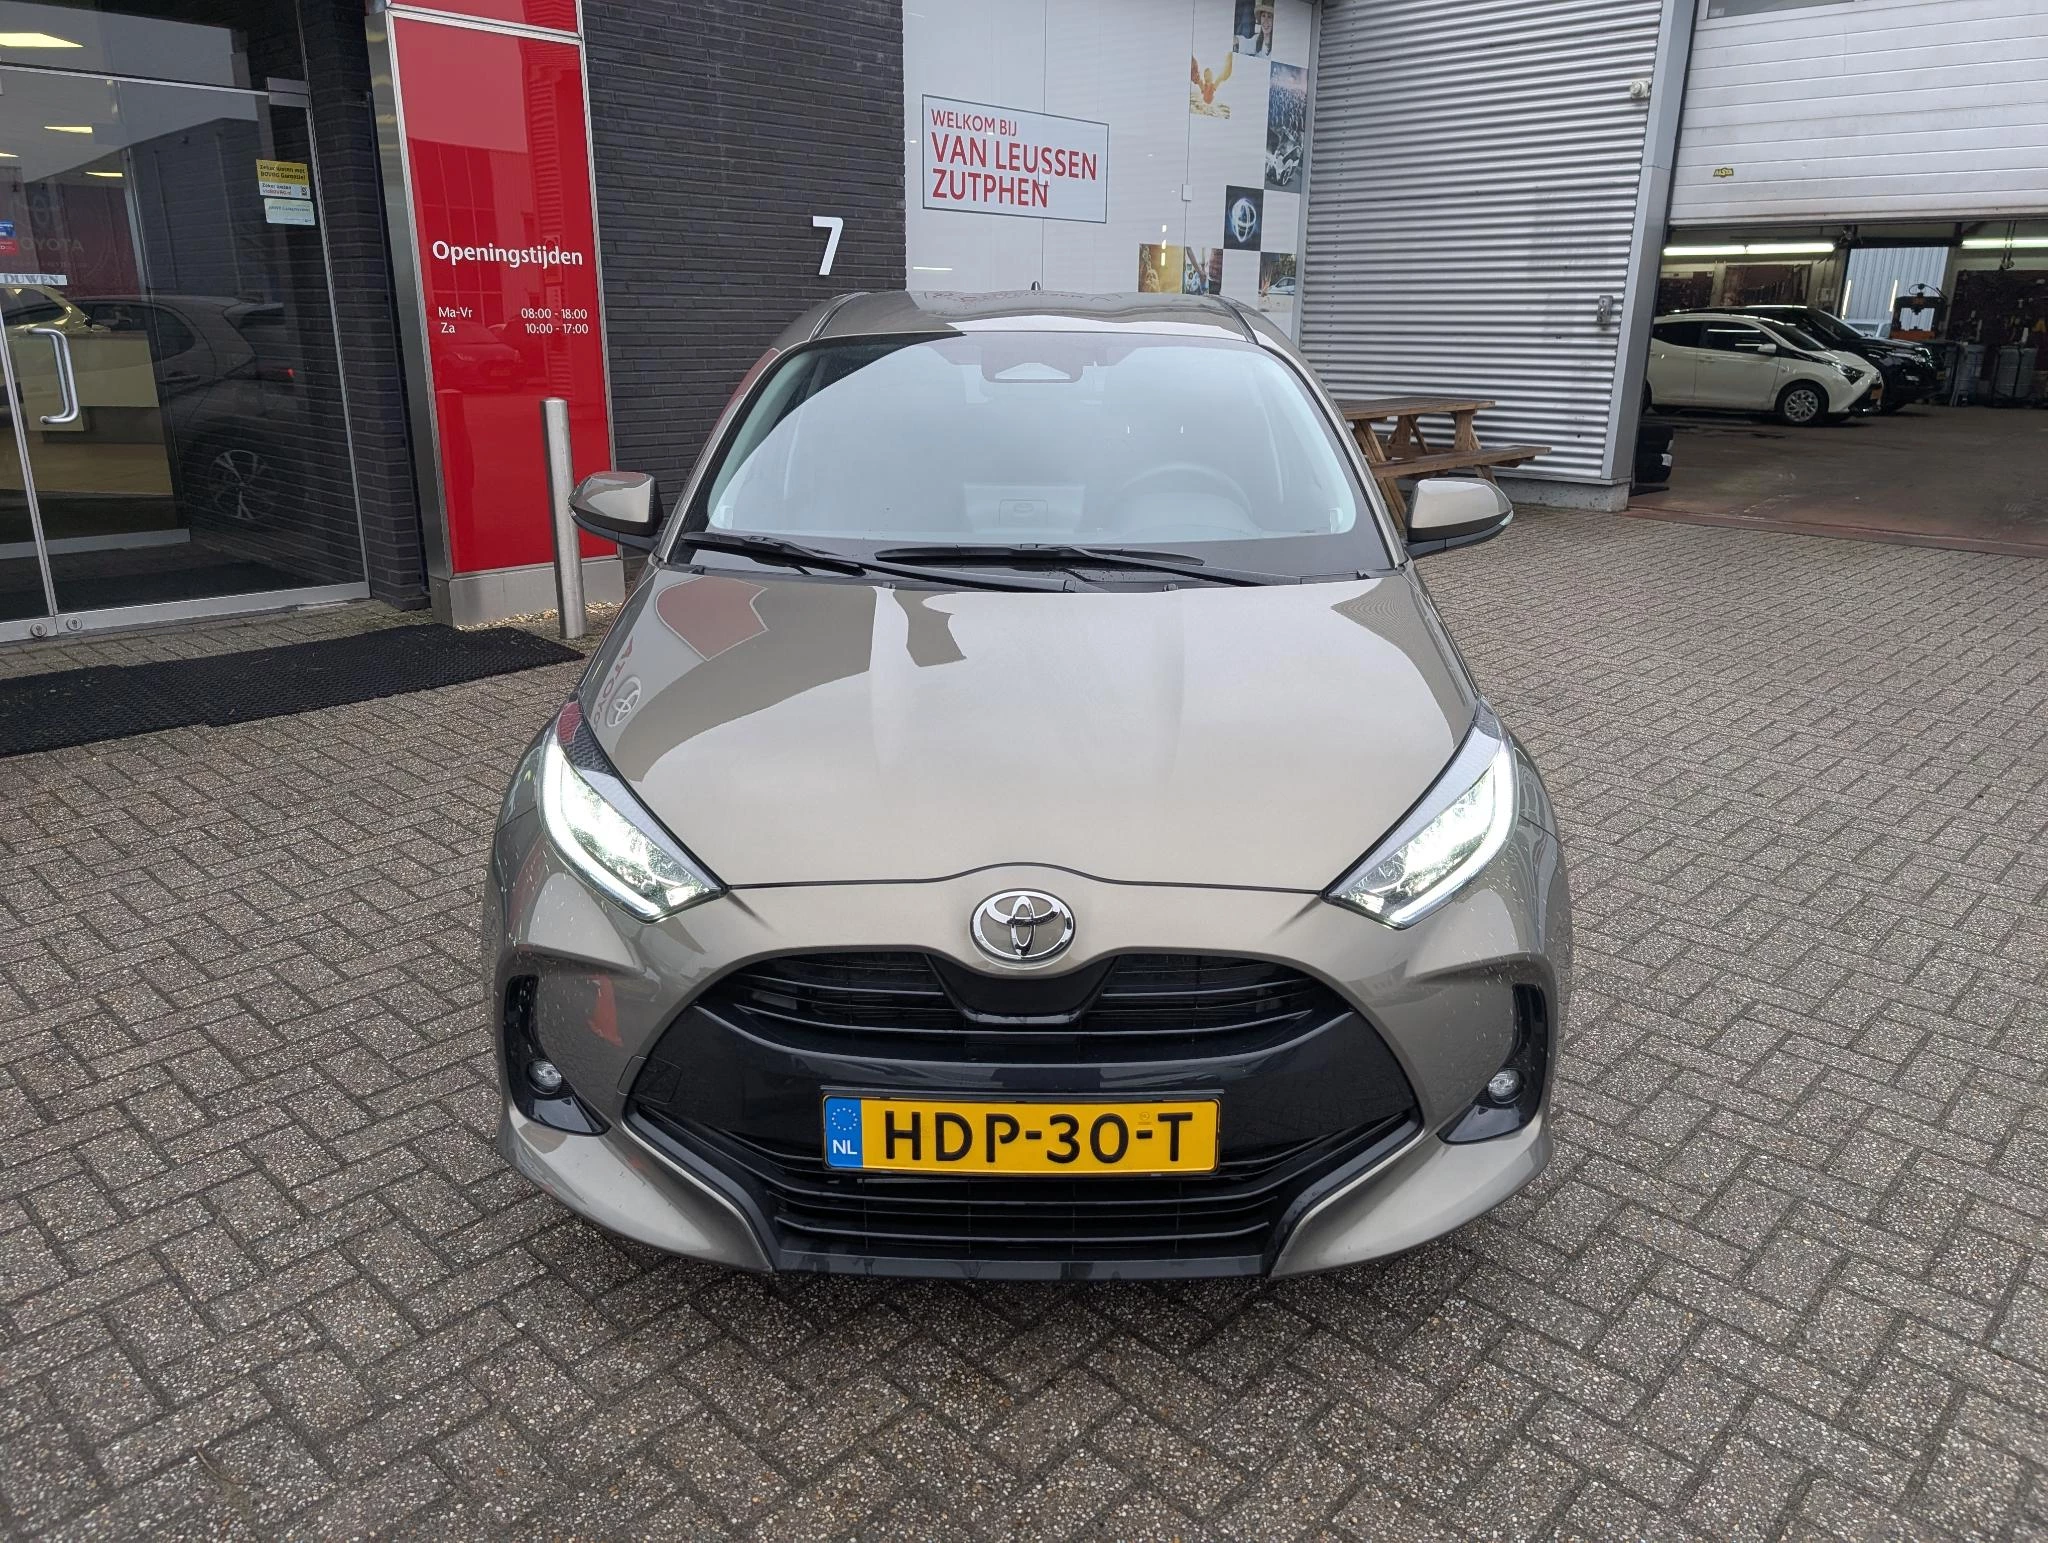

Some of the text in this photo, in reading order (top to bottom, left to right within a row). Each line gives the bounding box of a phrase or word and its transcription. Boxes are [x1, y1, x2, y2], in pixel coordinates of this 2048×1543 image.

[930, 108, 1018, 137] WELKOM BIJ
[930, 131, 1097, 181] VAN LEUSSEN
[932, 167, 1049, 208] ZUTPHEN
[19, 236, 85, 253] OYOTA
[812, 215, 844, 276] 7
[432, 240, 584, 270] Openingstijden
[4, 273, 60, 285] DUWEN
[438, 306, 473, 319] Ma-Vr
[521, 308, 552, 320] 08:00
[561, 308, 588, 320] 18:00
[441, 322, 456, 334] Za
[526, 323, 553, 334] 10:00
[563, 323, 589, 334] 17:00
[884, 1110, 1194, 1164] HDP-30-T
[832, 1139, 858, 1156] NL
